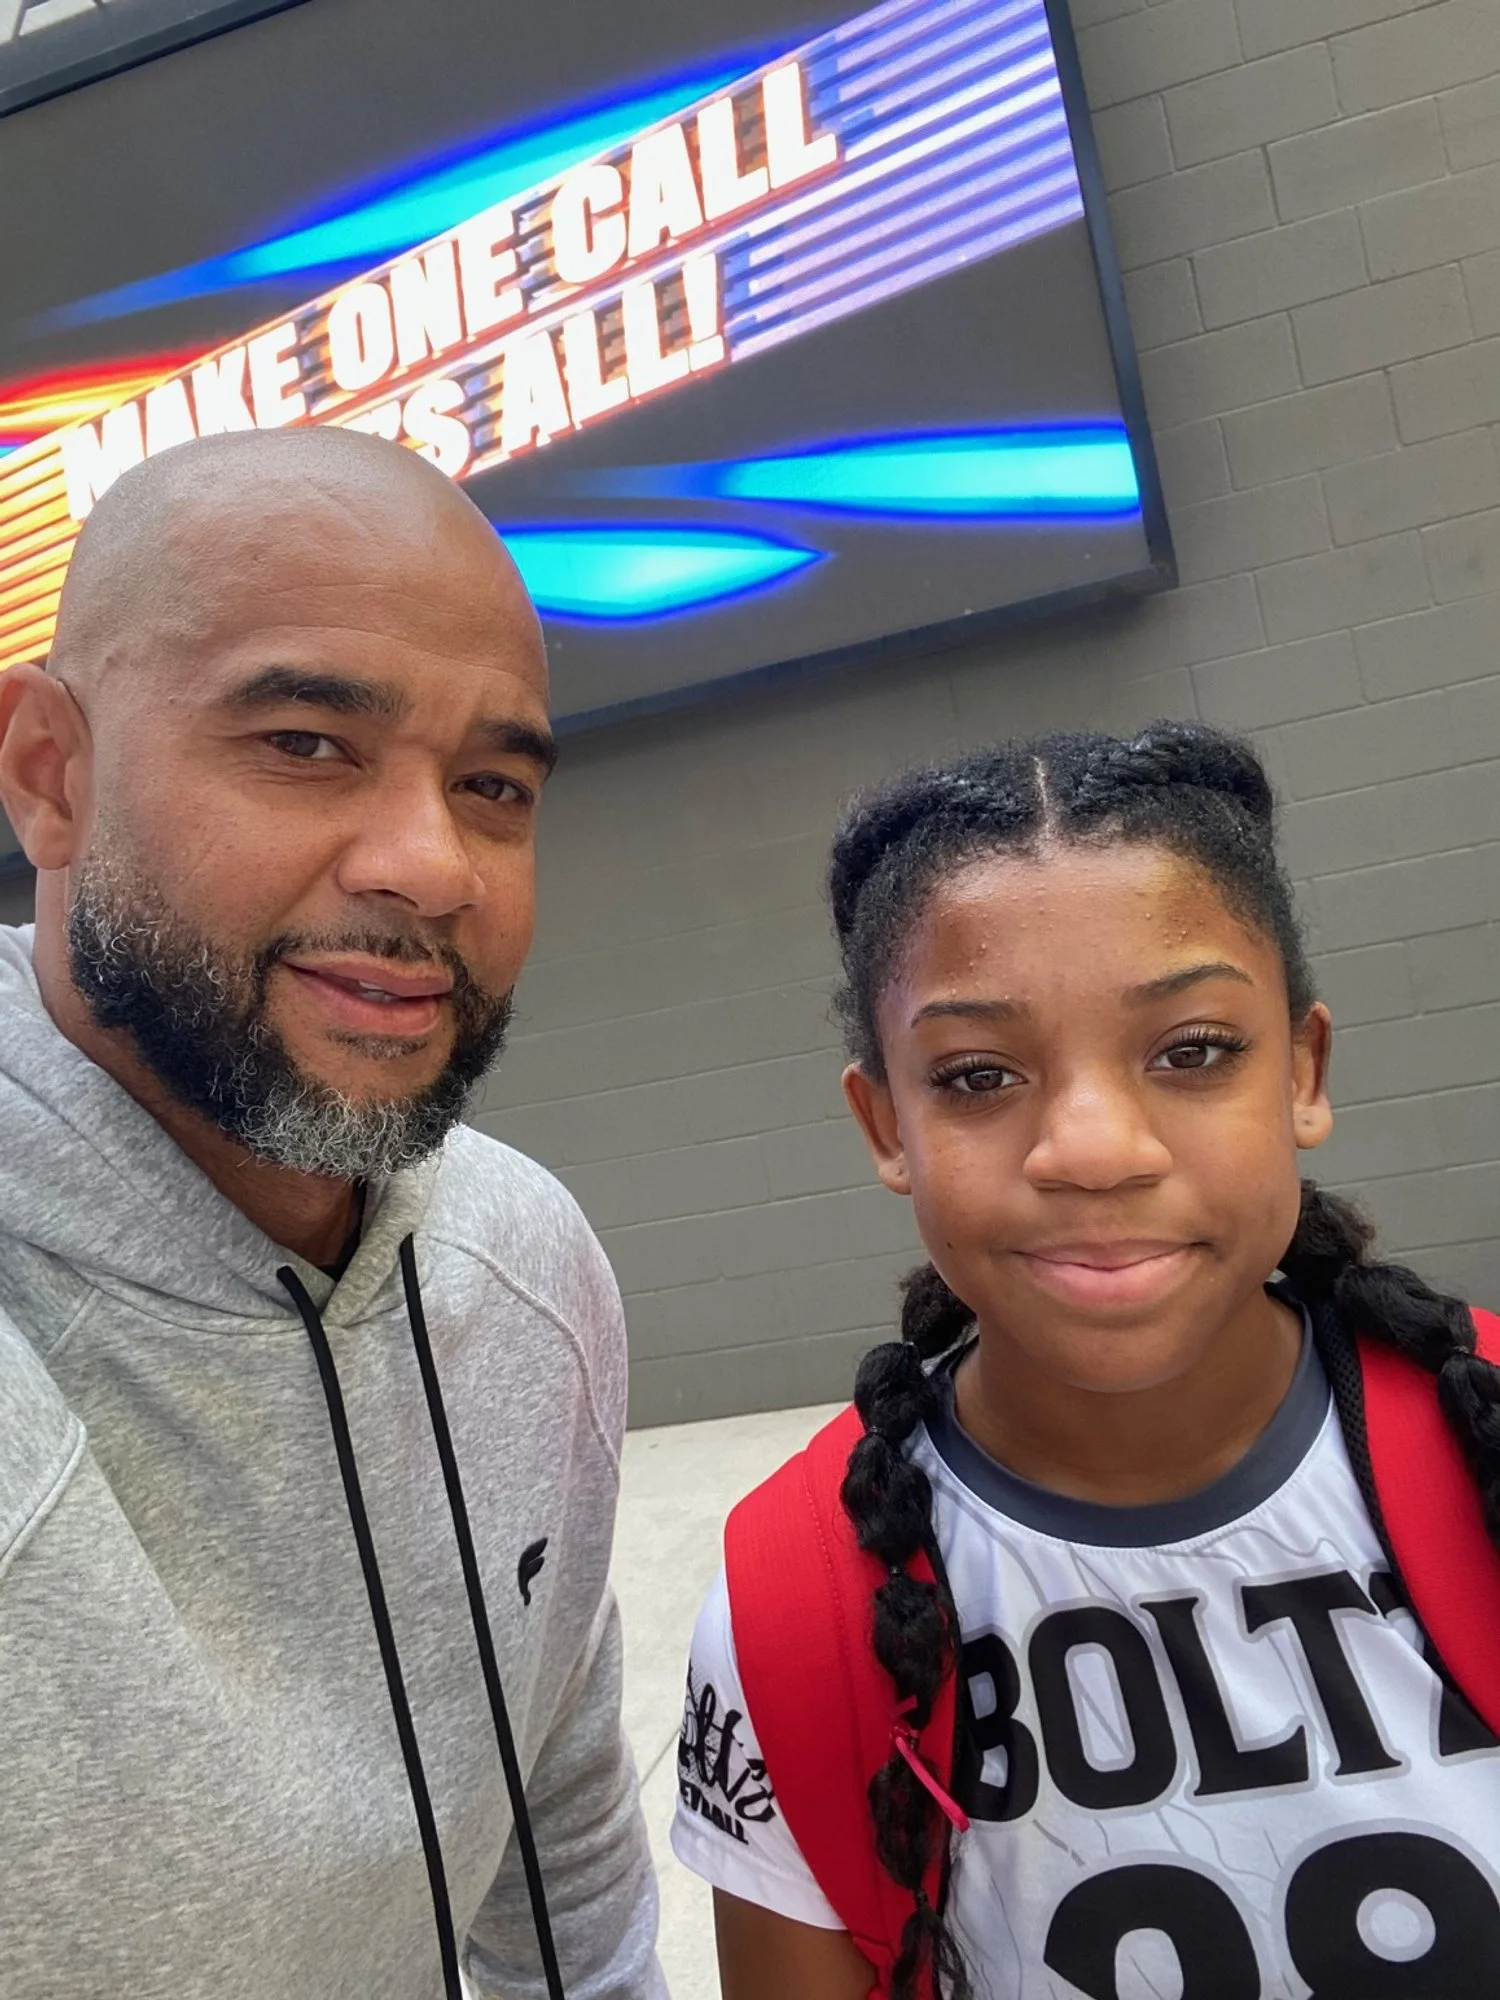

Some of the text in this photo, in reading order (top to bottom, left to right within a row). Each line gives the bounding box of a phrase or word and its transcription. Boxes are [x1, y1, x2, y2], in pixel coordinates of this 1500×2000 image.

[61, 62, 838, 522] MAKE ONE CALL
[500, 252, 725, 458] ALL!
